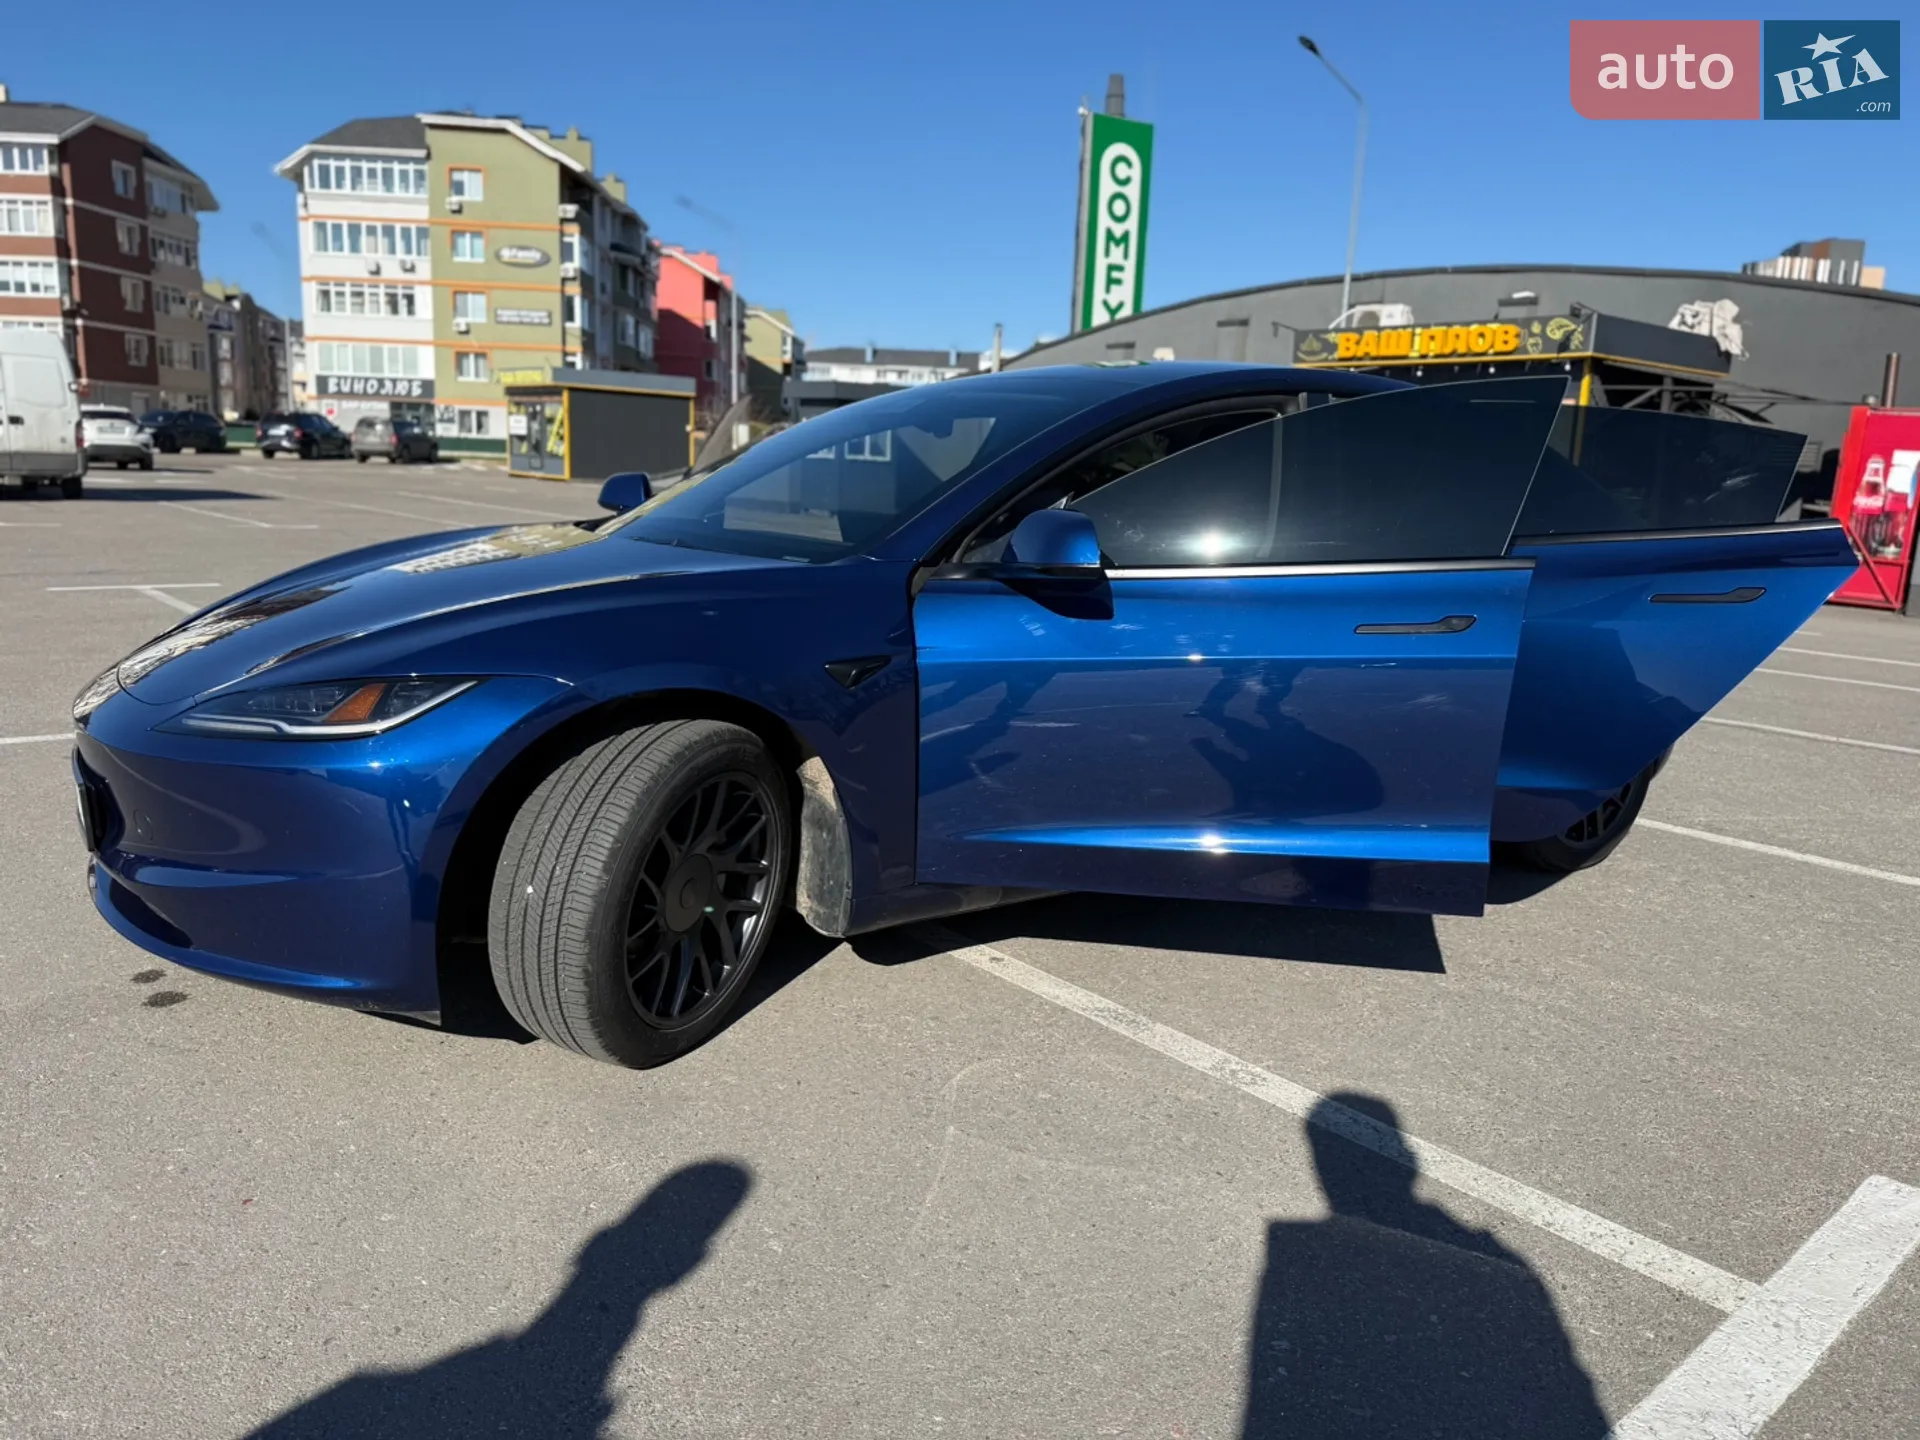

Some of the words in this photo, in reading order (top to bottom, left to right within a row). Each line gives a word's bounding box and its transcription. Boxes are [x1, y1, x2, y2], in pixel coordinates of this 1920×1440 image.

[1101, 154, 1133, 321] COMFY
[1337, 331, 1413, 360] ВАШ
[1420, 324, 1521, 357] ПЛОВ
